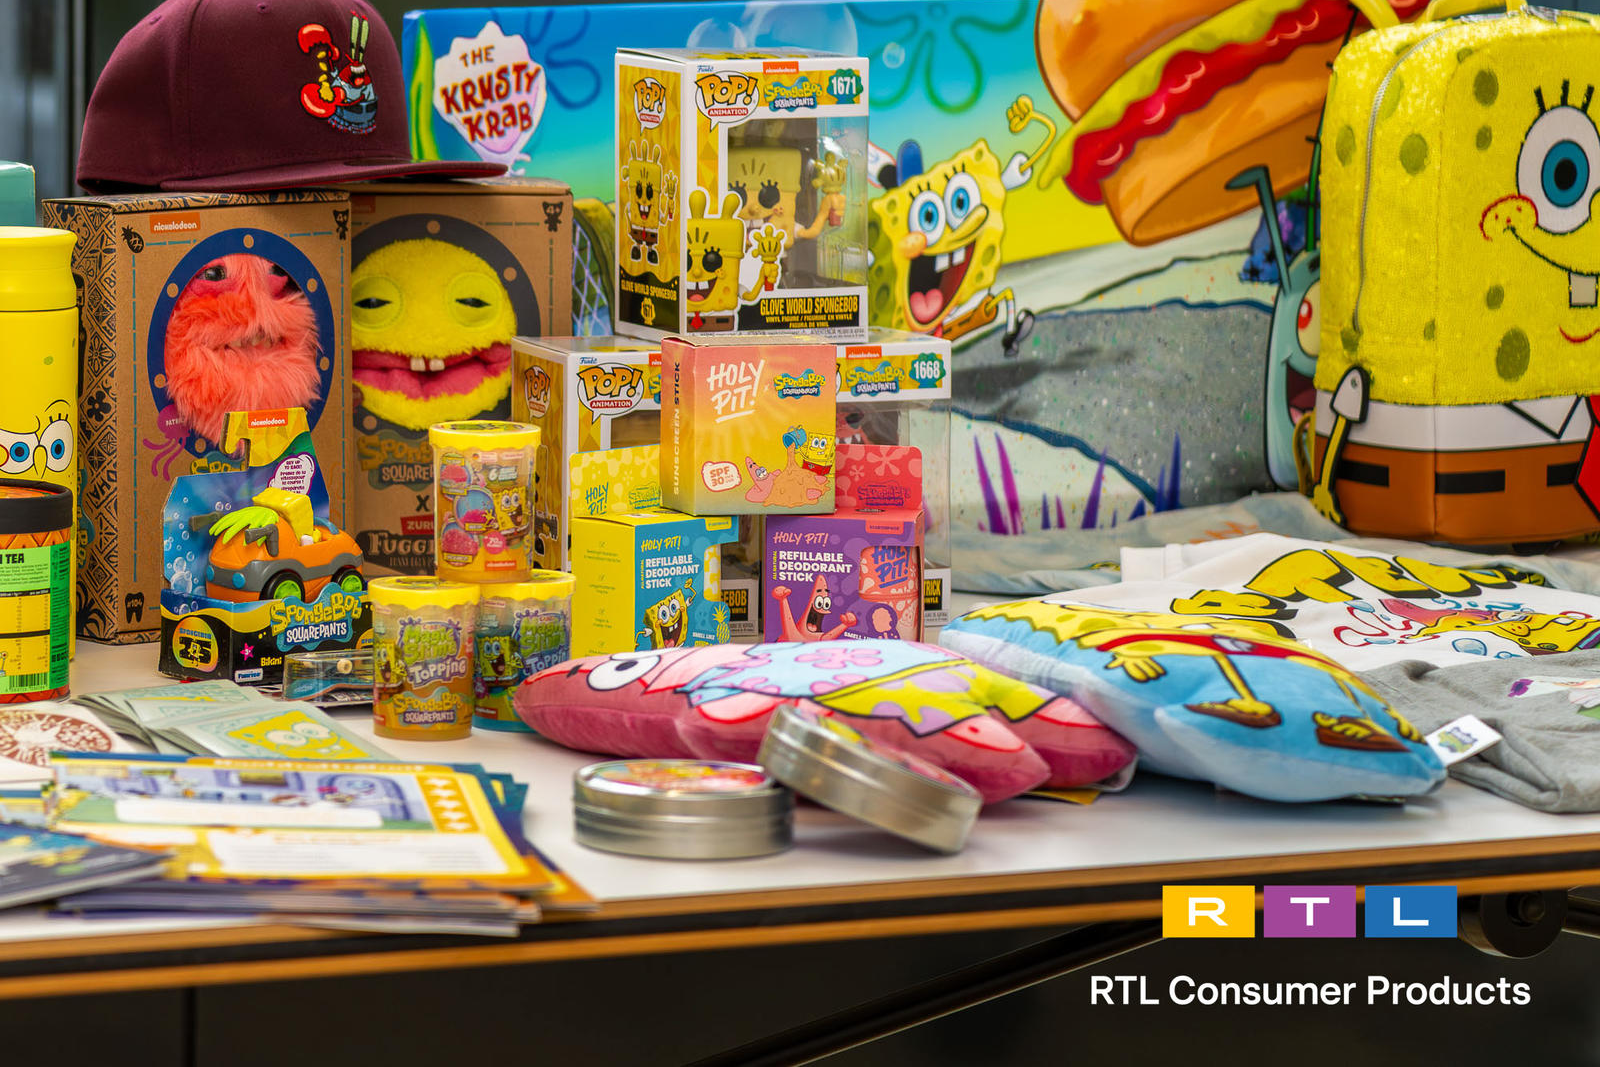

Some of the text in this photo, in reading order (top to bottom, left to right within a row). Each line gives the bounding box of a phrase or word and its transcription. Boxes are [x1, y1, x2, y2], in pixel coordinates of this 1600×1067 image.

[460, 45, 495, 67] THE
[440, 62, 541, 118] KRUSTY
[695, 74, 758, 108] POP!
[764, 82, 822, 101] SpongeBob
[831, 77, 856, 94] 1671
[634, 79, 665, 113] POP!
[154, 221, 197, 231] nickelodeon
[760, 296, 858, 316] GLOVE WORLD SPONGEBOB
[706, 359, 766, 396] HOLY
[846, 366, 906, 387] SpongeBob
[913, 361, 941, 379] 1668
[524, 366, 551, 400] POP!
[577, 366, 643, 400] POP!
[251, 418, 286, 426] nickelodeon
[710, 467, 730, 479] SPF
[711, 476, 724, 487] 30
[585, 482, 609, 504] HOLY
[416, 495, 430, 512] X
[641, 538, 662, 552] HOLY
[773, 532, 803, 545] HOLY
[6, 553, 25, 564] TEA
[646, 555, 692, 567] REFILLABLE
[779, 551, 843, 562] REFILLABLE
[645, 565, 699, 578] DEODORANT
[779, 562, 852, 573] DEODORANT
[645, 578, 672, 589] STICK
[779, 572, 814, 582] STICK
[270, 592, 363, 637] SpongeBob
[286, 622, 347, 644] SQUAREPANTS
[260, 656, 282, 667] Bikini
[392, 692, 462, 714] SpongeBob
[404, 711, 454, 723] SQUAREPANTS
